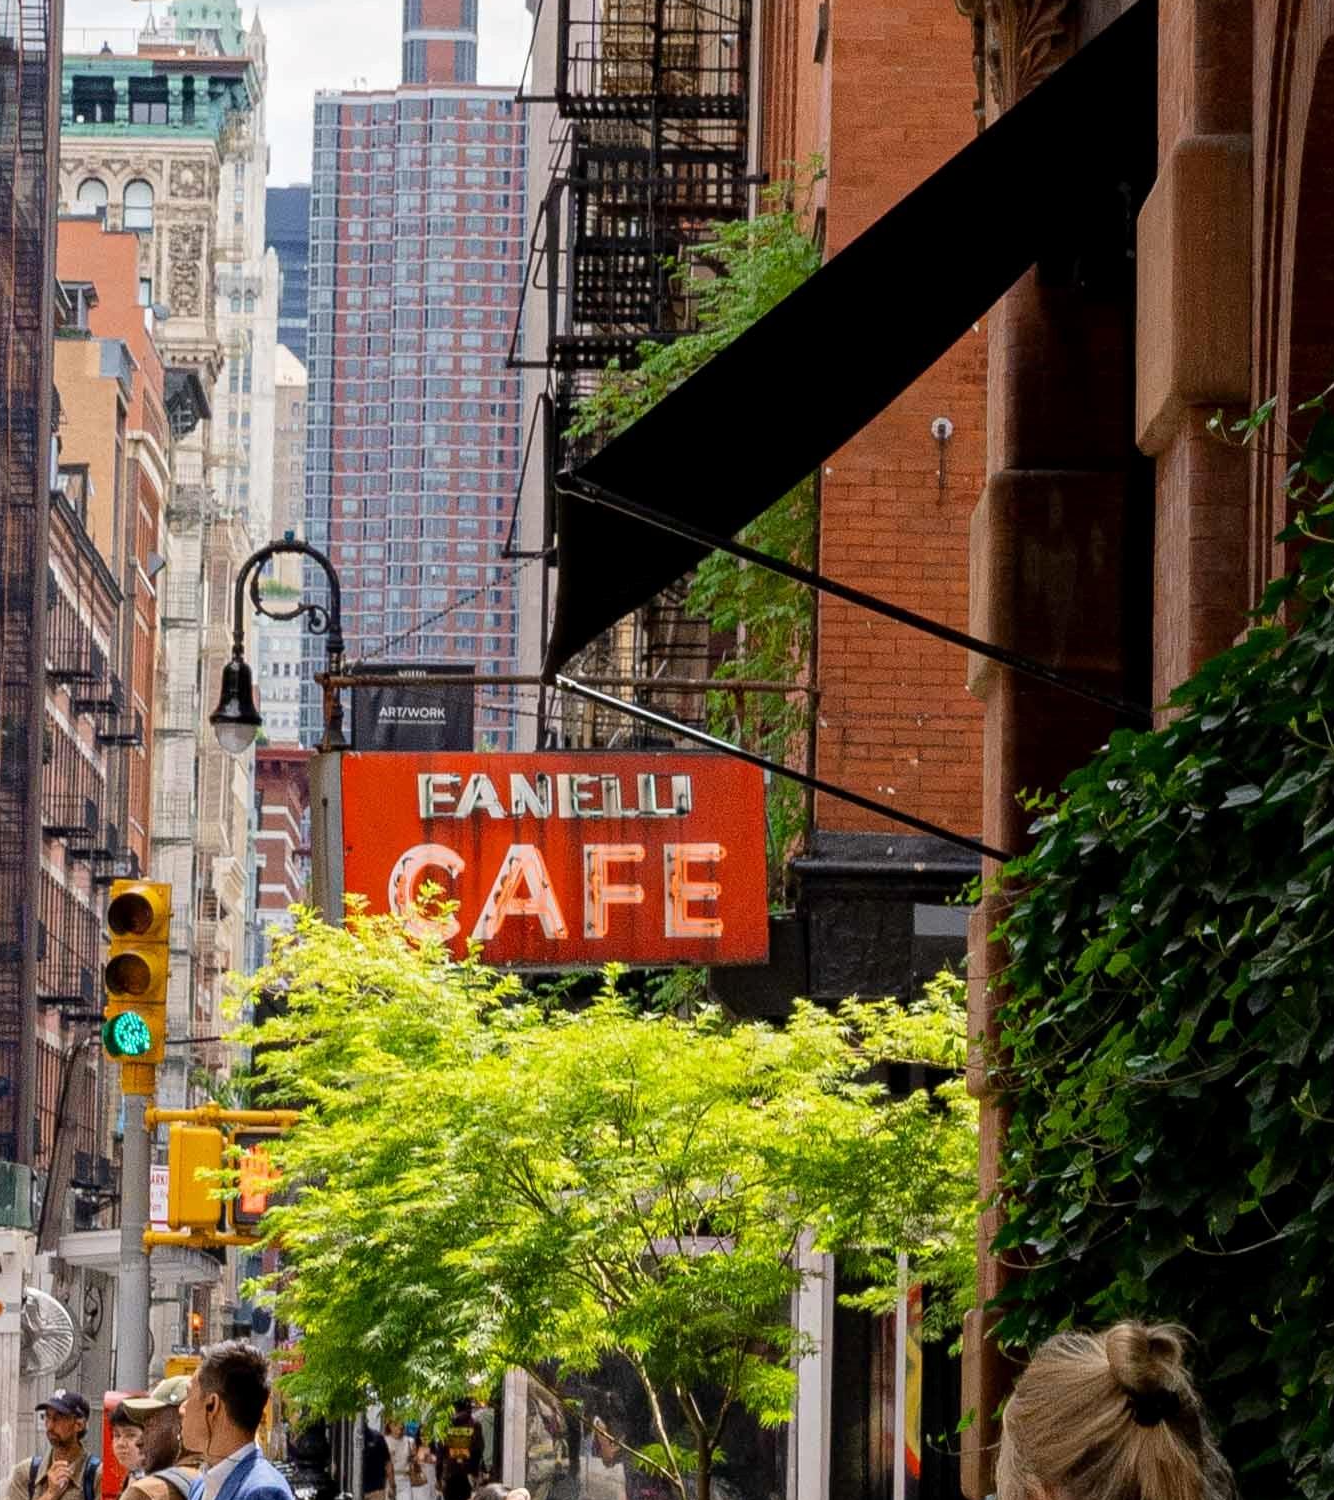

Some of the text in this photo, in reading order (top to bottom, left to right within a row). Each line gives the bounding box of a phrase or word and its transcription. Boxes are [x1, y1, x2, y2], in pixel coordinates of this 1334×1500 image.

[378, 706, 446, 719] ART/WORK
[417, 772, 693, 819] FANELLI
[388, 843, 726, 940] CAFE
